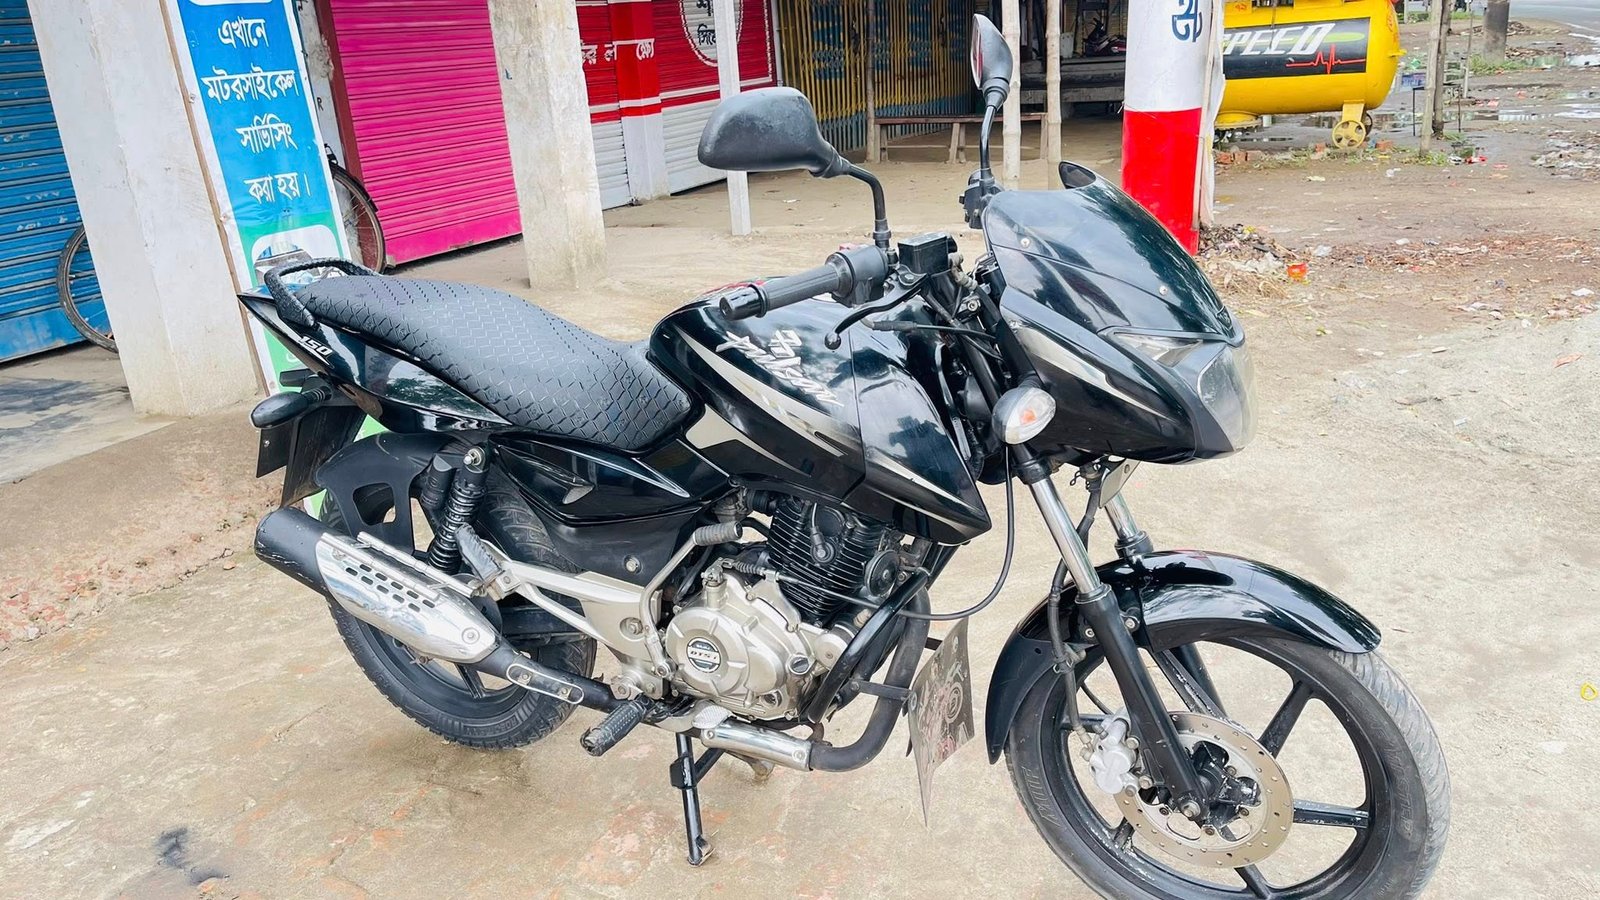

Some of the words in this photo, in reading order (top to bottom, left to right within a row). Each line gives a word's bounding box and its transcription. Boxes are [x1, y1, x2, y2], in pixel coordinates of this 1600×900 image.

[218, 16, 269, 48] এখানে
[201, 63, 299, 104] মটরসাইকেল
[236, 113, 298, 154] সার্ভিসিং
[244, 175, 275, 204] করা
[299, 335, 333, 356] 150
